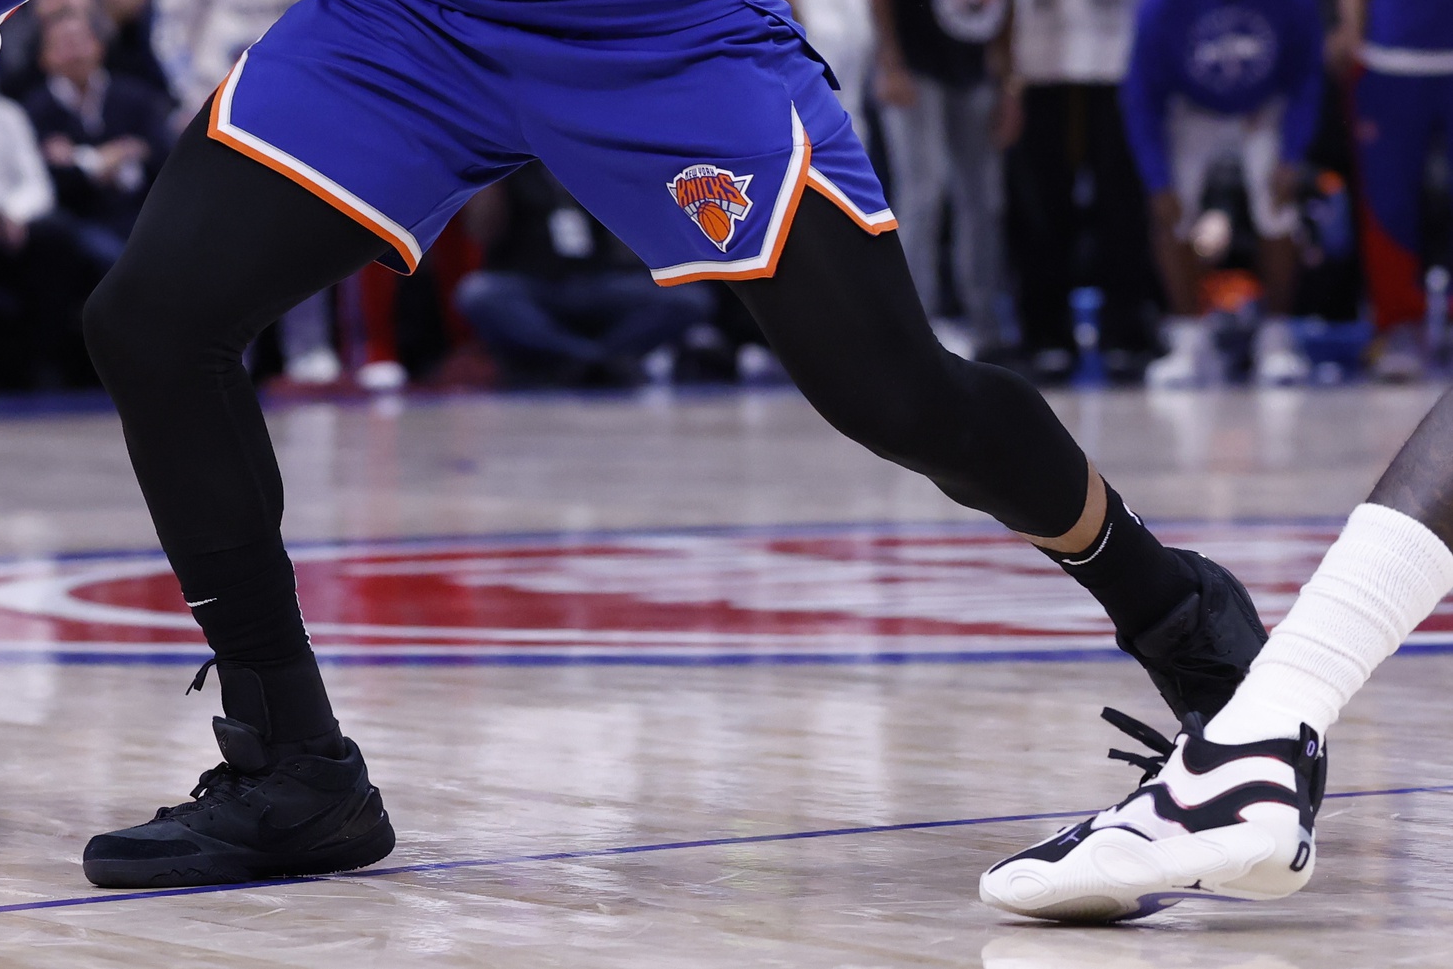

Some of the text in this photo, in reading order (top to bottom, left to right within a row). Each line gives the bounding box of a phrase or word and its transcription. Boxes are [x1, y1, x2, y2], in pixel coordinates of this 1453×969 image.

[684, 166, 717, 180] NEW YORK
[676, 173, 748, 209] KNICKS
